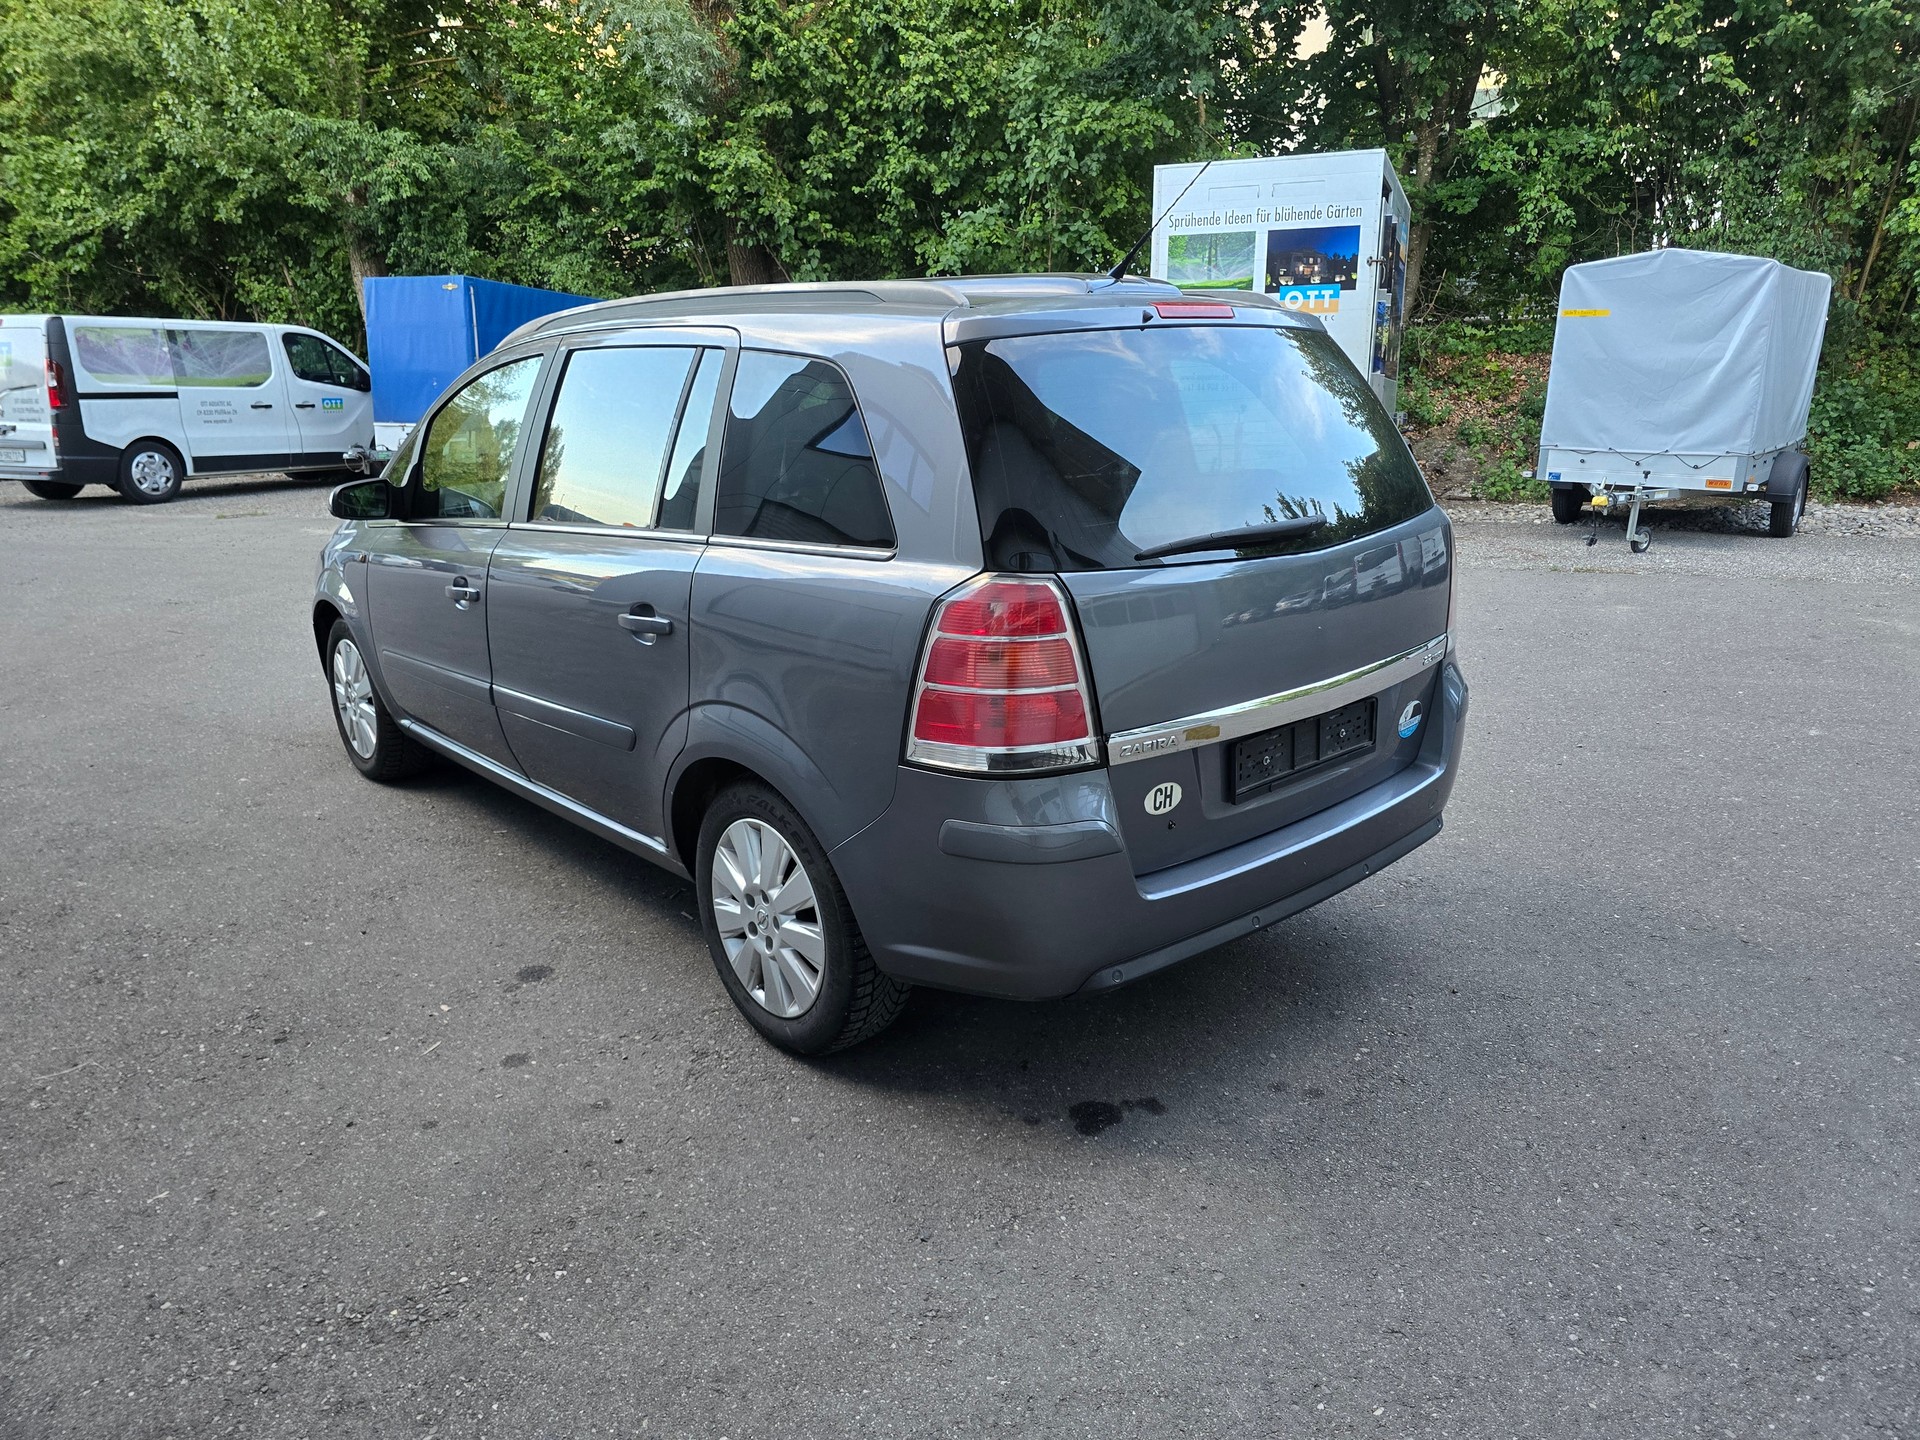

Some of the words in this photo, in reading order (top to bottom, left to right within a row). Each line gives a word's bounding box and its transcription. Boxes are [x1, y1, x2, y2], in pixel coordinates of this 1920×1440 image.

[1168, 211, 1221, 231] Sprühende
[1224, 209, 1252, 225] Ideen
[1256, 207, 1271, 223] für
[1274, 205, 1323, 222] blühende
[1326, 204, 1362, 219] Gärten
[1284, 289, 1334, 309] OTT
[323, 399, 342, 408] OTT
[1119, 735, 1178, 757] ZAFIRA
[1153, 785, 1173, 812] CH
